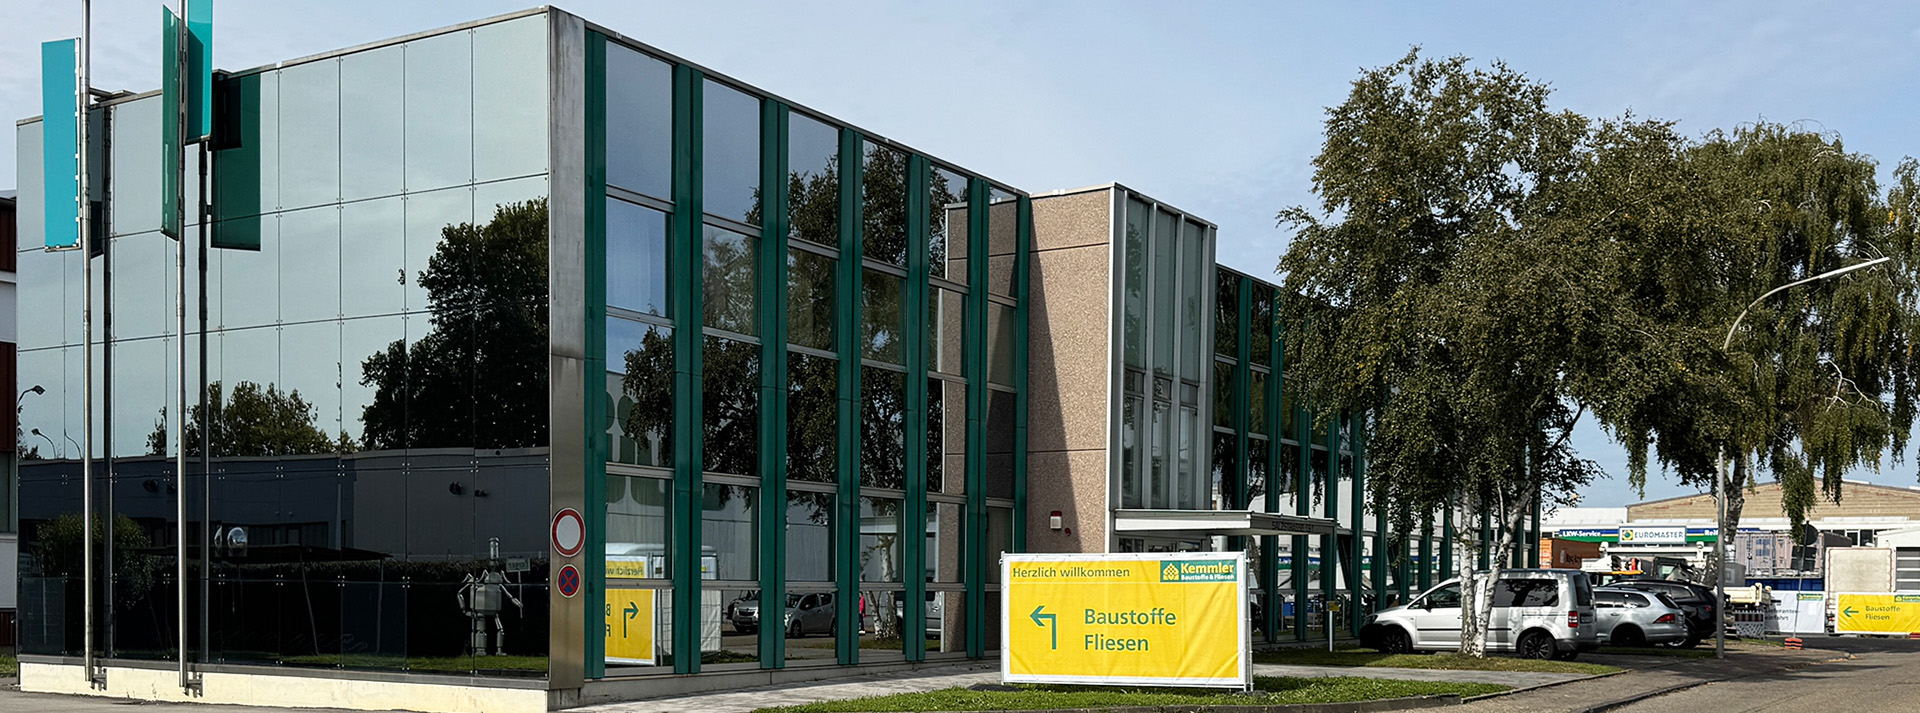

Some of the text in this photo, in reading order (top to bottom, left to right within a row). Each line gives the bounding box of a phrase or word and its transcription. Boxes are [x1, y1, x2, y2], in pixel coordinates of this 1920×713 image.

[1634, 531, 1684, 539] EUROMASTER
[1012, 566, 1130, 578] Herzlich willkommen
[1181, 562, 1234, 574] Kemmler
[1084, 607, 1177, 625] Baustoffe
[1084, 634, 1149, 651] Fliesen
